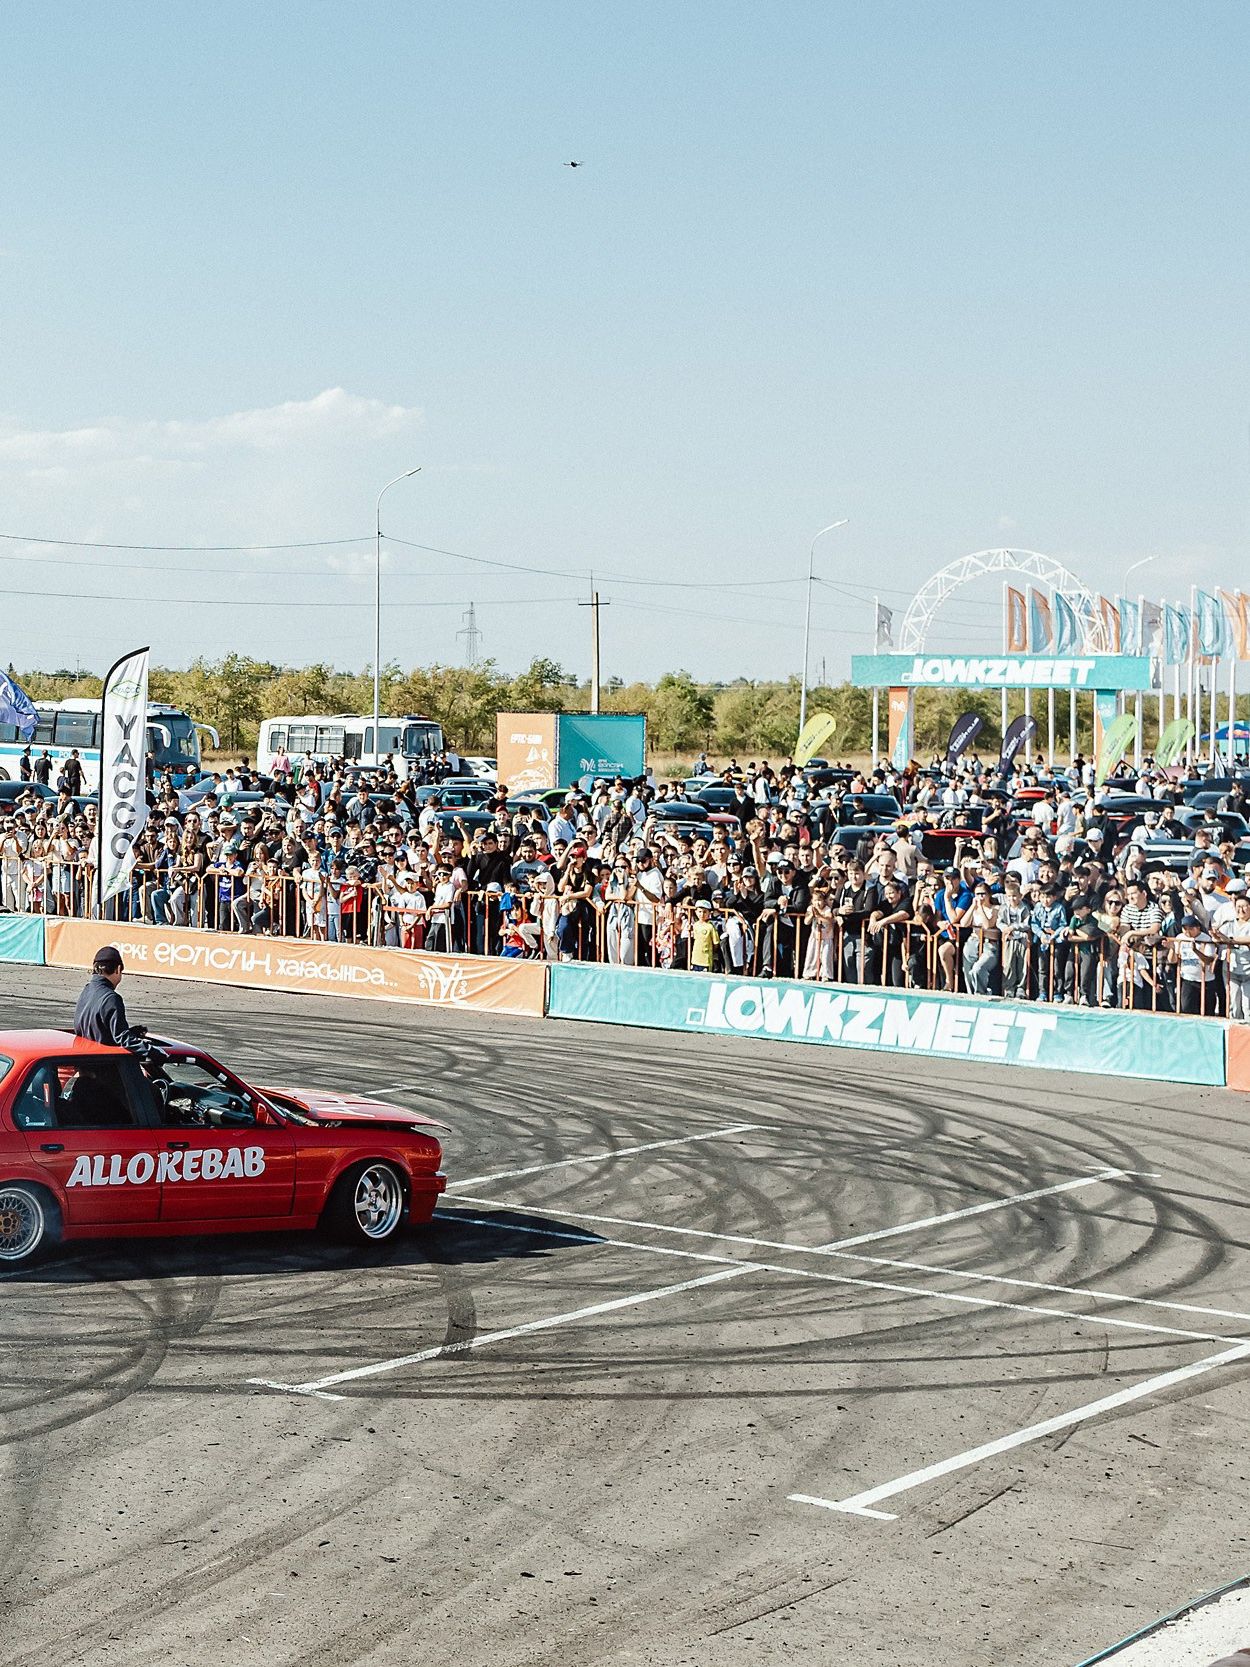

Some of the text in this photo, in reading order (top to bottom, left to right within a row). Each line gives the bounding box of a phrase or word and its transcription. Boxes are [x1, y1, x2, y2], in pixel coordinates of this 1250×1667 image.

[911, 659, 1096, 684] LOWKZMEET
[111, 714, 138, 860] YACCO
[705, 982, 1057, 1060] LOWKZMEET
[65, 1146, 266, 1187] ALLO KEBAB
